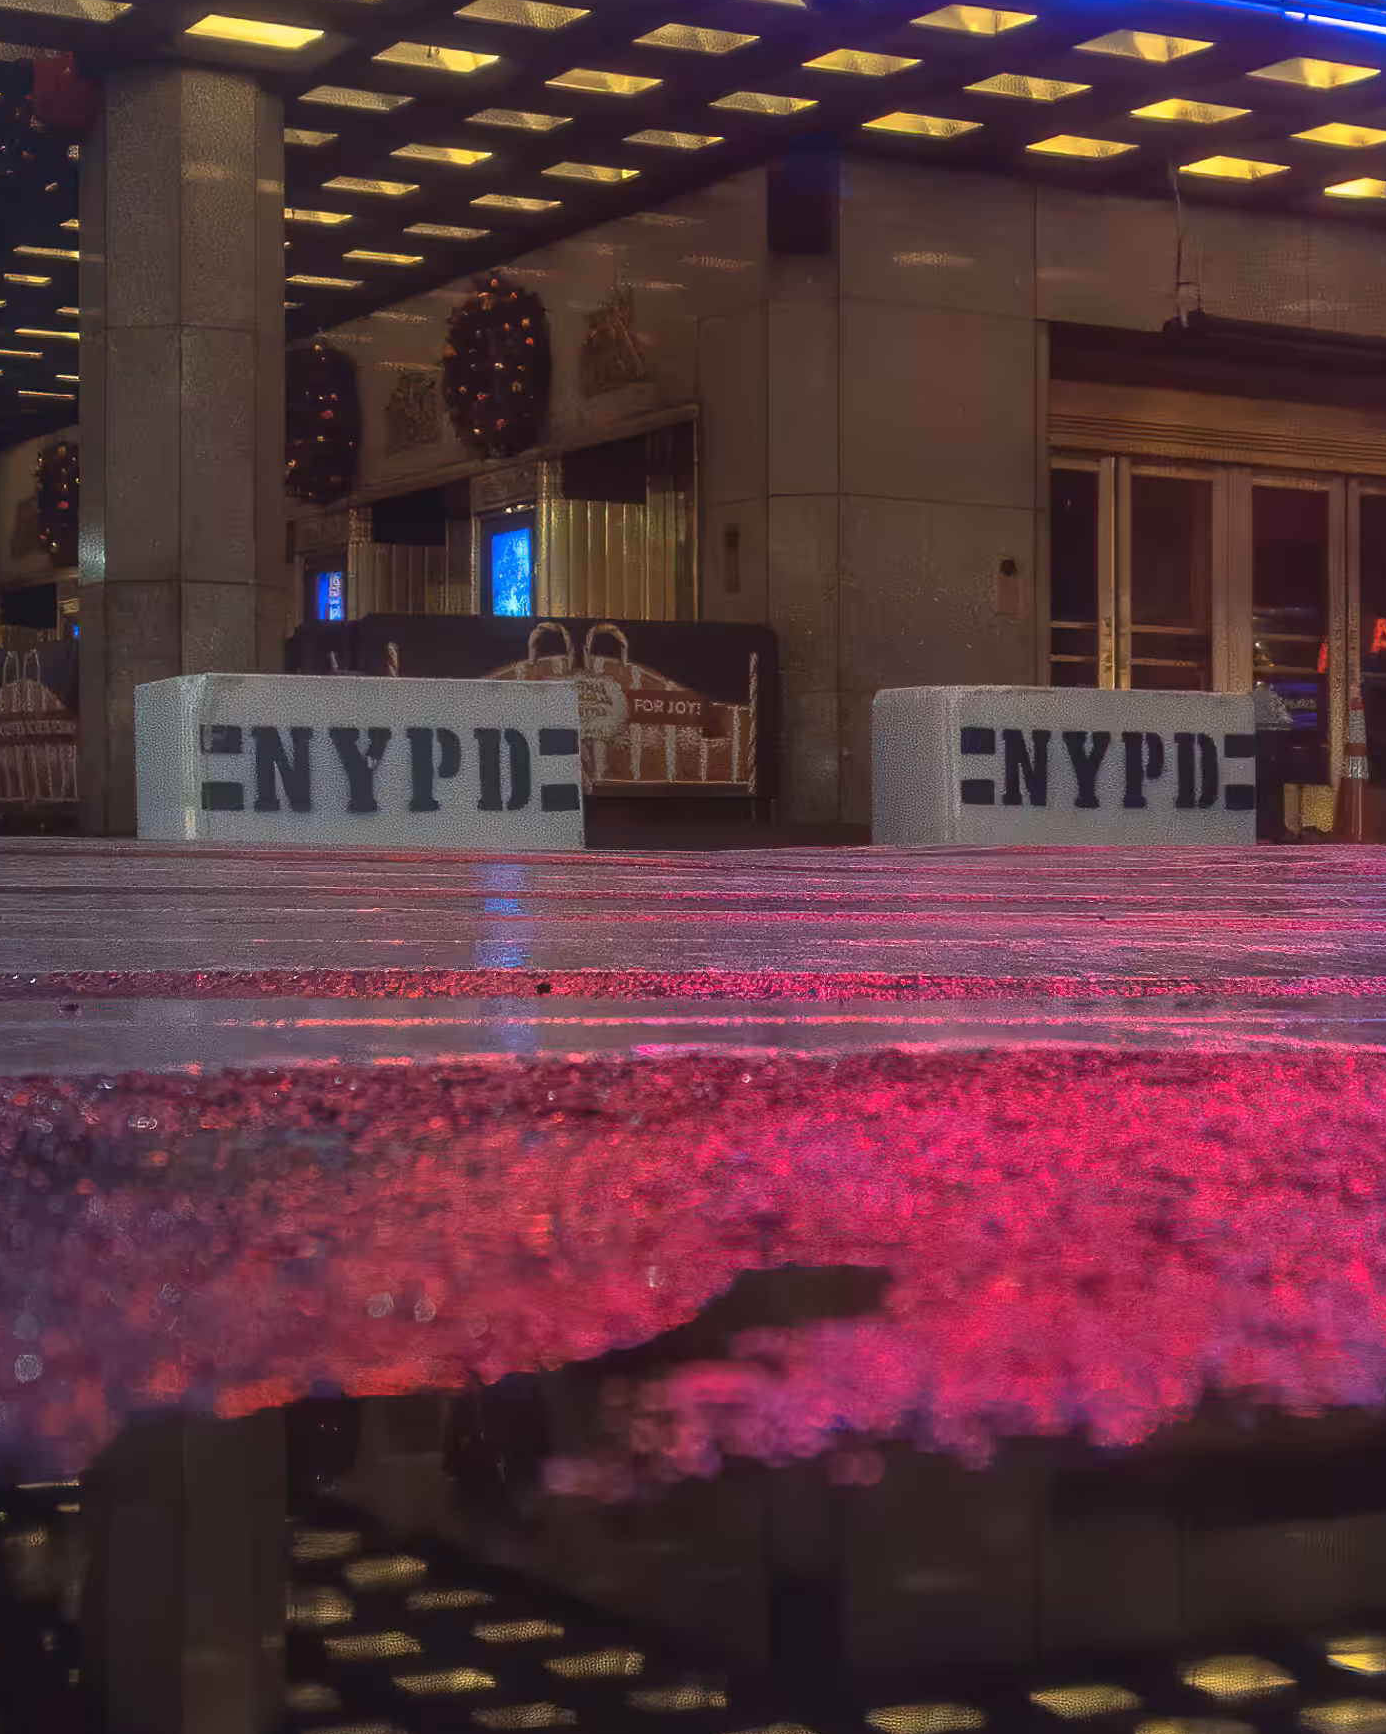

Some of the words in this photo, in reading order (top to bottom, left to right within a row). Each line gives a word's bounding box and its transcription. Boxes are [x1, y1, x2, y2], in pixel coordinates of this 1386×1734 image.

[634, 698, 664, 714] FOR
[253, 726, 534, 813] NYPD
[1003, 727, 1221, 810] NYPD
